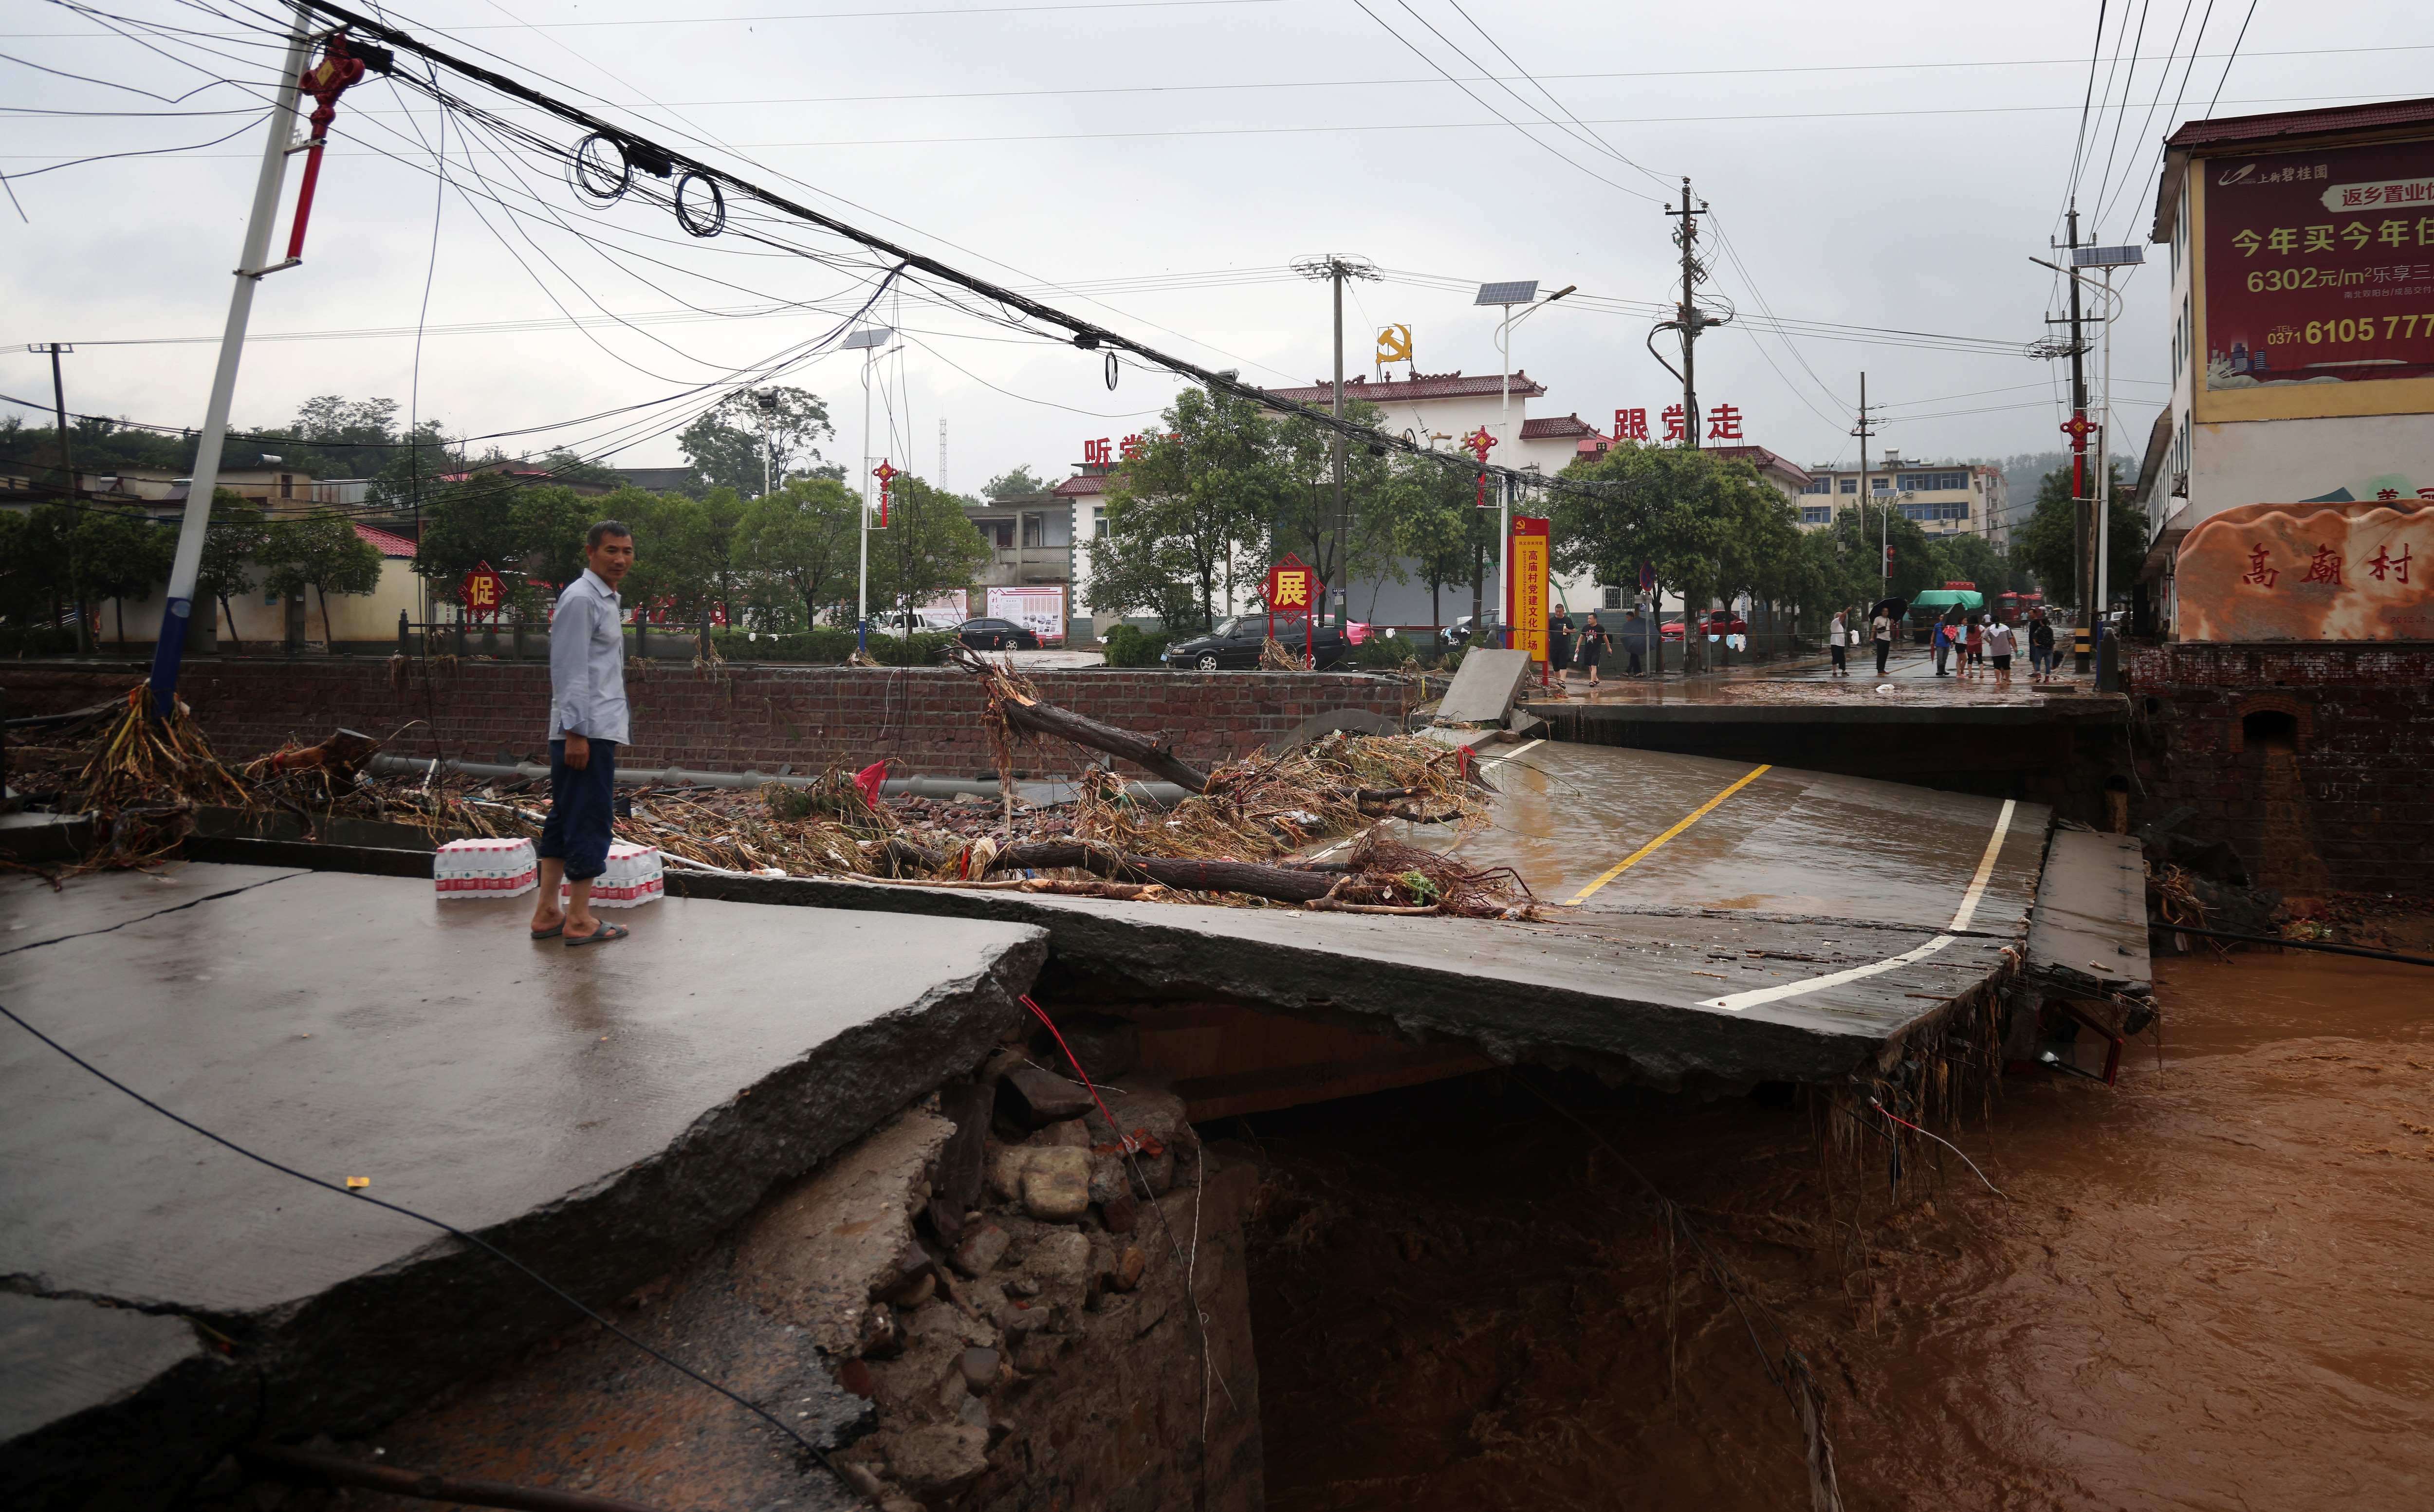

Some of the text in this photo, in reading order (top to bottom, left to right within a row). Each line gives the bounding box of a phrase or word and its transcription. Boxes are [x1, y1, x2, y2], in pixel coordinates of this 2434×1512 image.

[2373, 264, 2434, 283] 乐享三
[2344, 285, 2434, 299] 南北双阳台/成品交付
[2268, 331, 2301, 345] 0371
[2305, 317, 2375, 344] 6105
[1613, 404, 1743, 442] 跟党走
[470, 576, 495, 606] 促
[1274, 572, 1307, 606] 展
[1528, 550, 1538, 650] 高庙村党建文化广场
